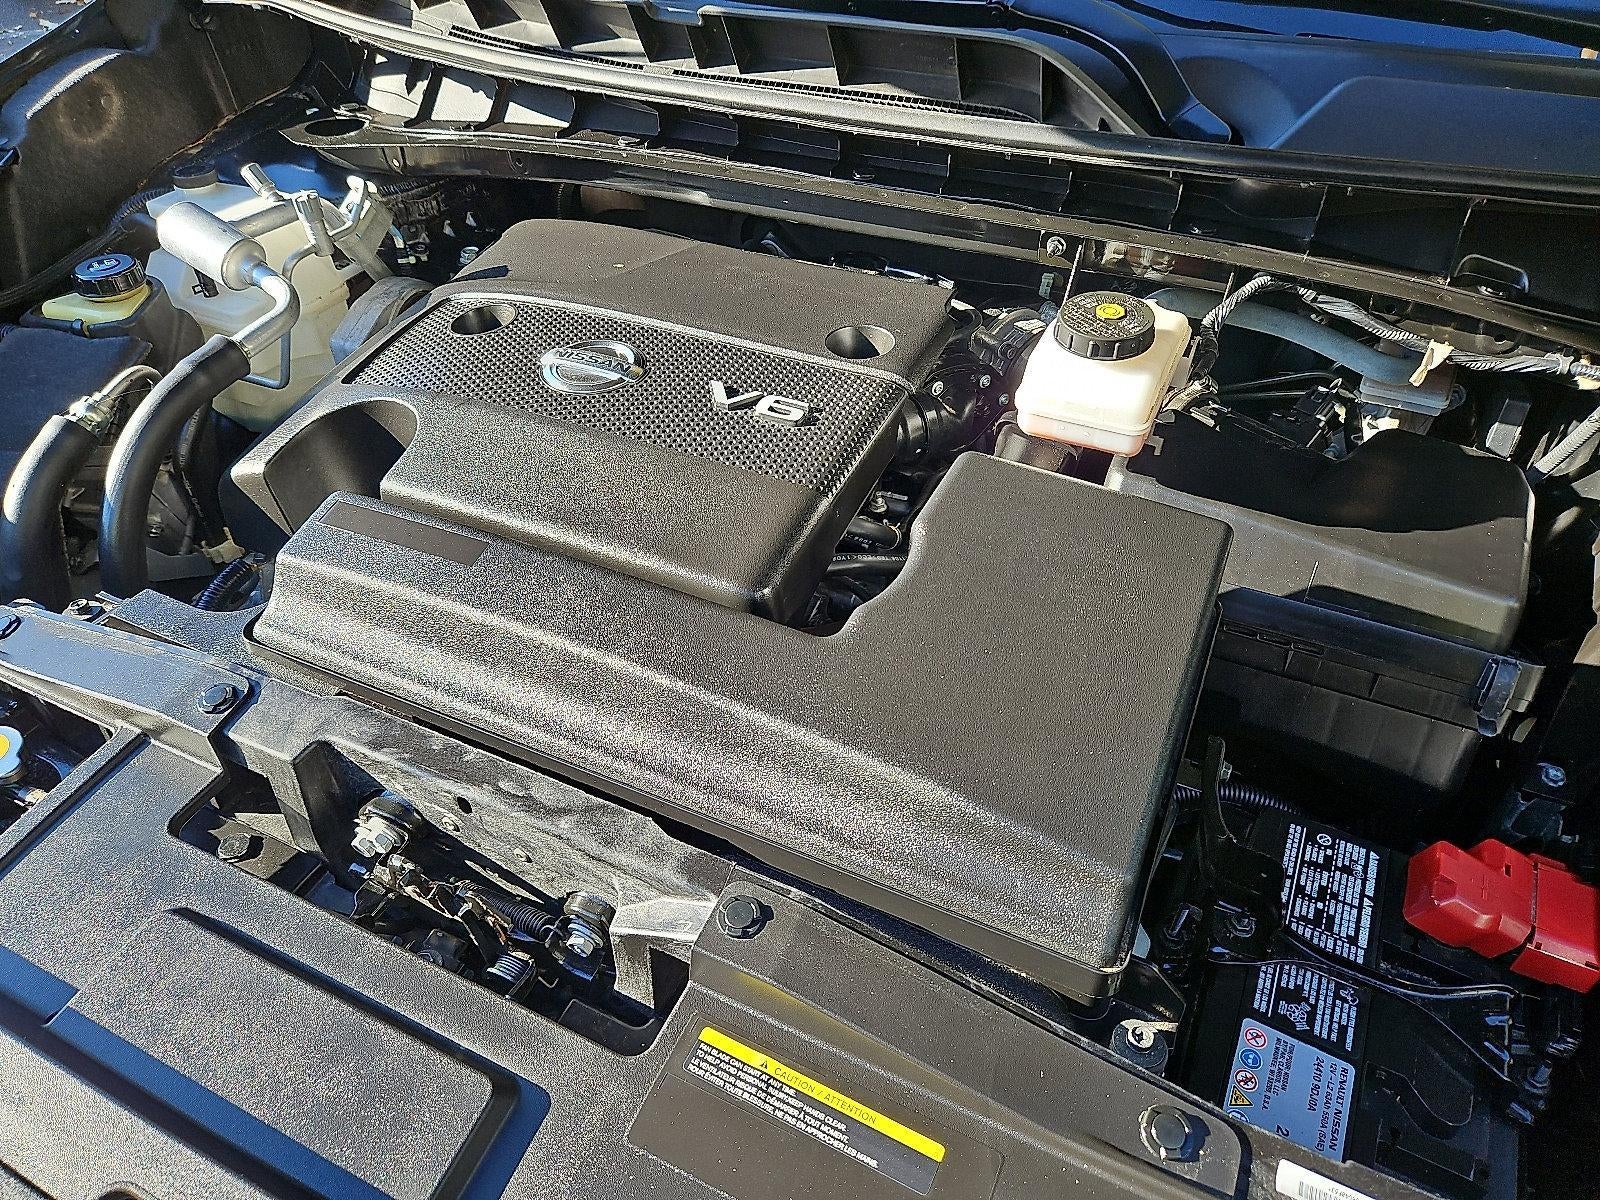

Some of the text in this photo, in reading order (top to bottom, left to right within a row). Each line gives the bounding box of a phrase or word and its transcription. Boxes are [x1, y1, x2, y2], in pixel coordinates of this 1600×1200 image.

[557, 349, 631, 374] NISSAN
[711, 380, 809, 426] V6
[698, 1042, 711, 1053] FAN
[710, 1048, 730, 1062] BLADE
[728, 1057, 743, 1069] CAN
[742, 1064, 761, 1078] START
[759, 1073, 769, 1082] AT
[767, 1077, 782, 1089] ANY
[1311, 1055, 1324, 1083] 24410
[1326, 1080, 1334, 1091] L2
[1328, 1061, 1337, 1075] 12V
[695, 1048, 705, 1058] TO
[703, 1053, 720, 1066] HELP
[718, 1060, 738, 1075] AVOID
[736, 1069, 768, 1091] PERSONAL
[802, 1103, 825, 1120] HANDS
[824, 1115, 848, 1132] CLEAR.
[698, 1060, 736, 1084] VENTILATEUR
[734, 1078, 758, 1095] RISQUE
[756, 1089, 767, 1100] DE
[765, 1094, 800, 1117] DÉMARRER
[803, 1114, 821, 1128] TOUT
[819, 1123, 850, 1143] MOMENT.
[773, 1066, 815, 1093] CAUTION
[823, 1091, 876, 1124] ATTENTION
[1323, 1090, 1332, 1110] 63Ah
[1328, 1065, 1348, 1151] RENAULT NISSAN
[686, 1063, 880, 1169] POUR ÉVITER TOUTE BLESSURE, NE PAS EN APPROCHER LES MAINS.
[1319, 1109, 1329, 1130] 550A
